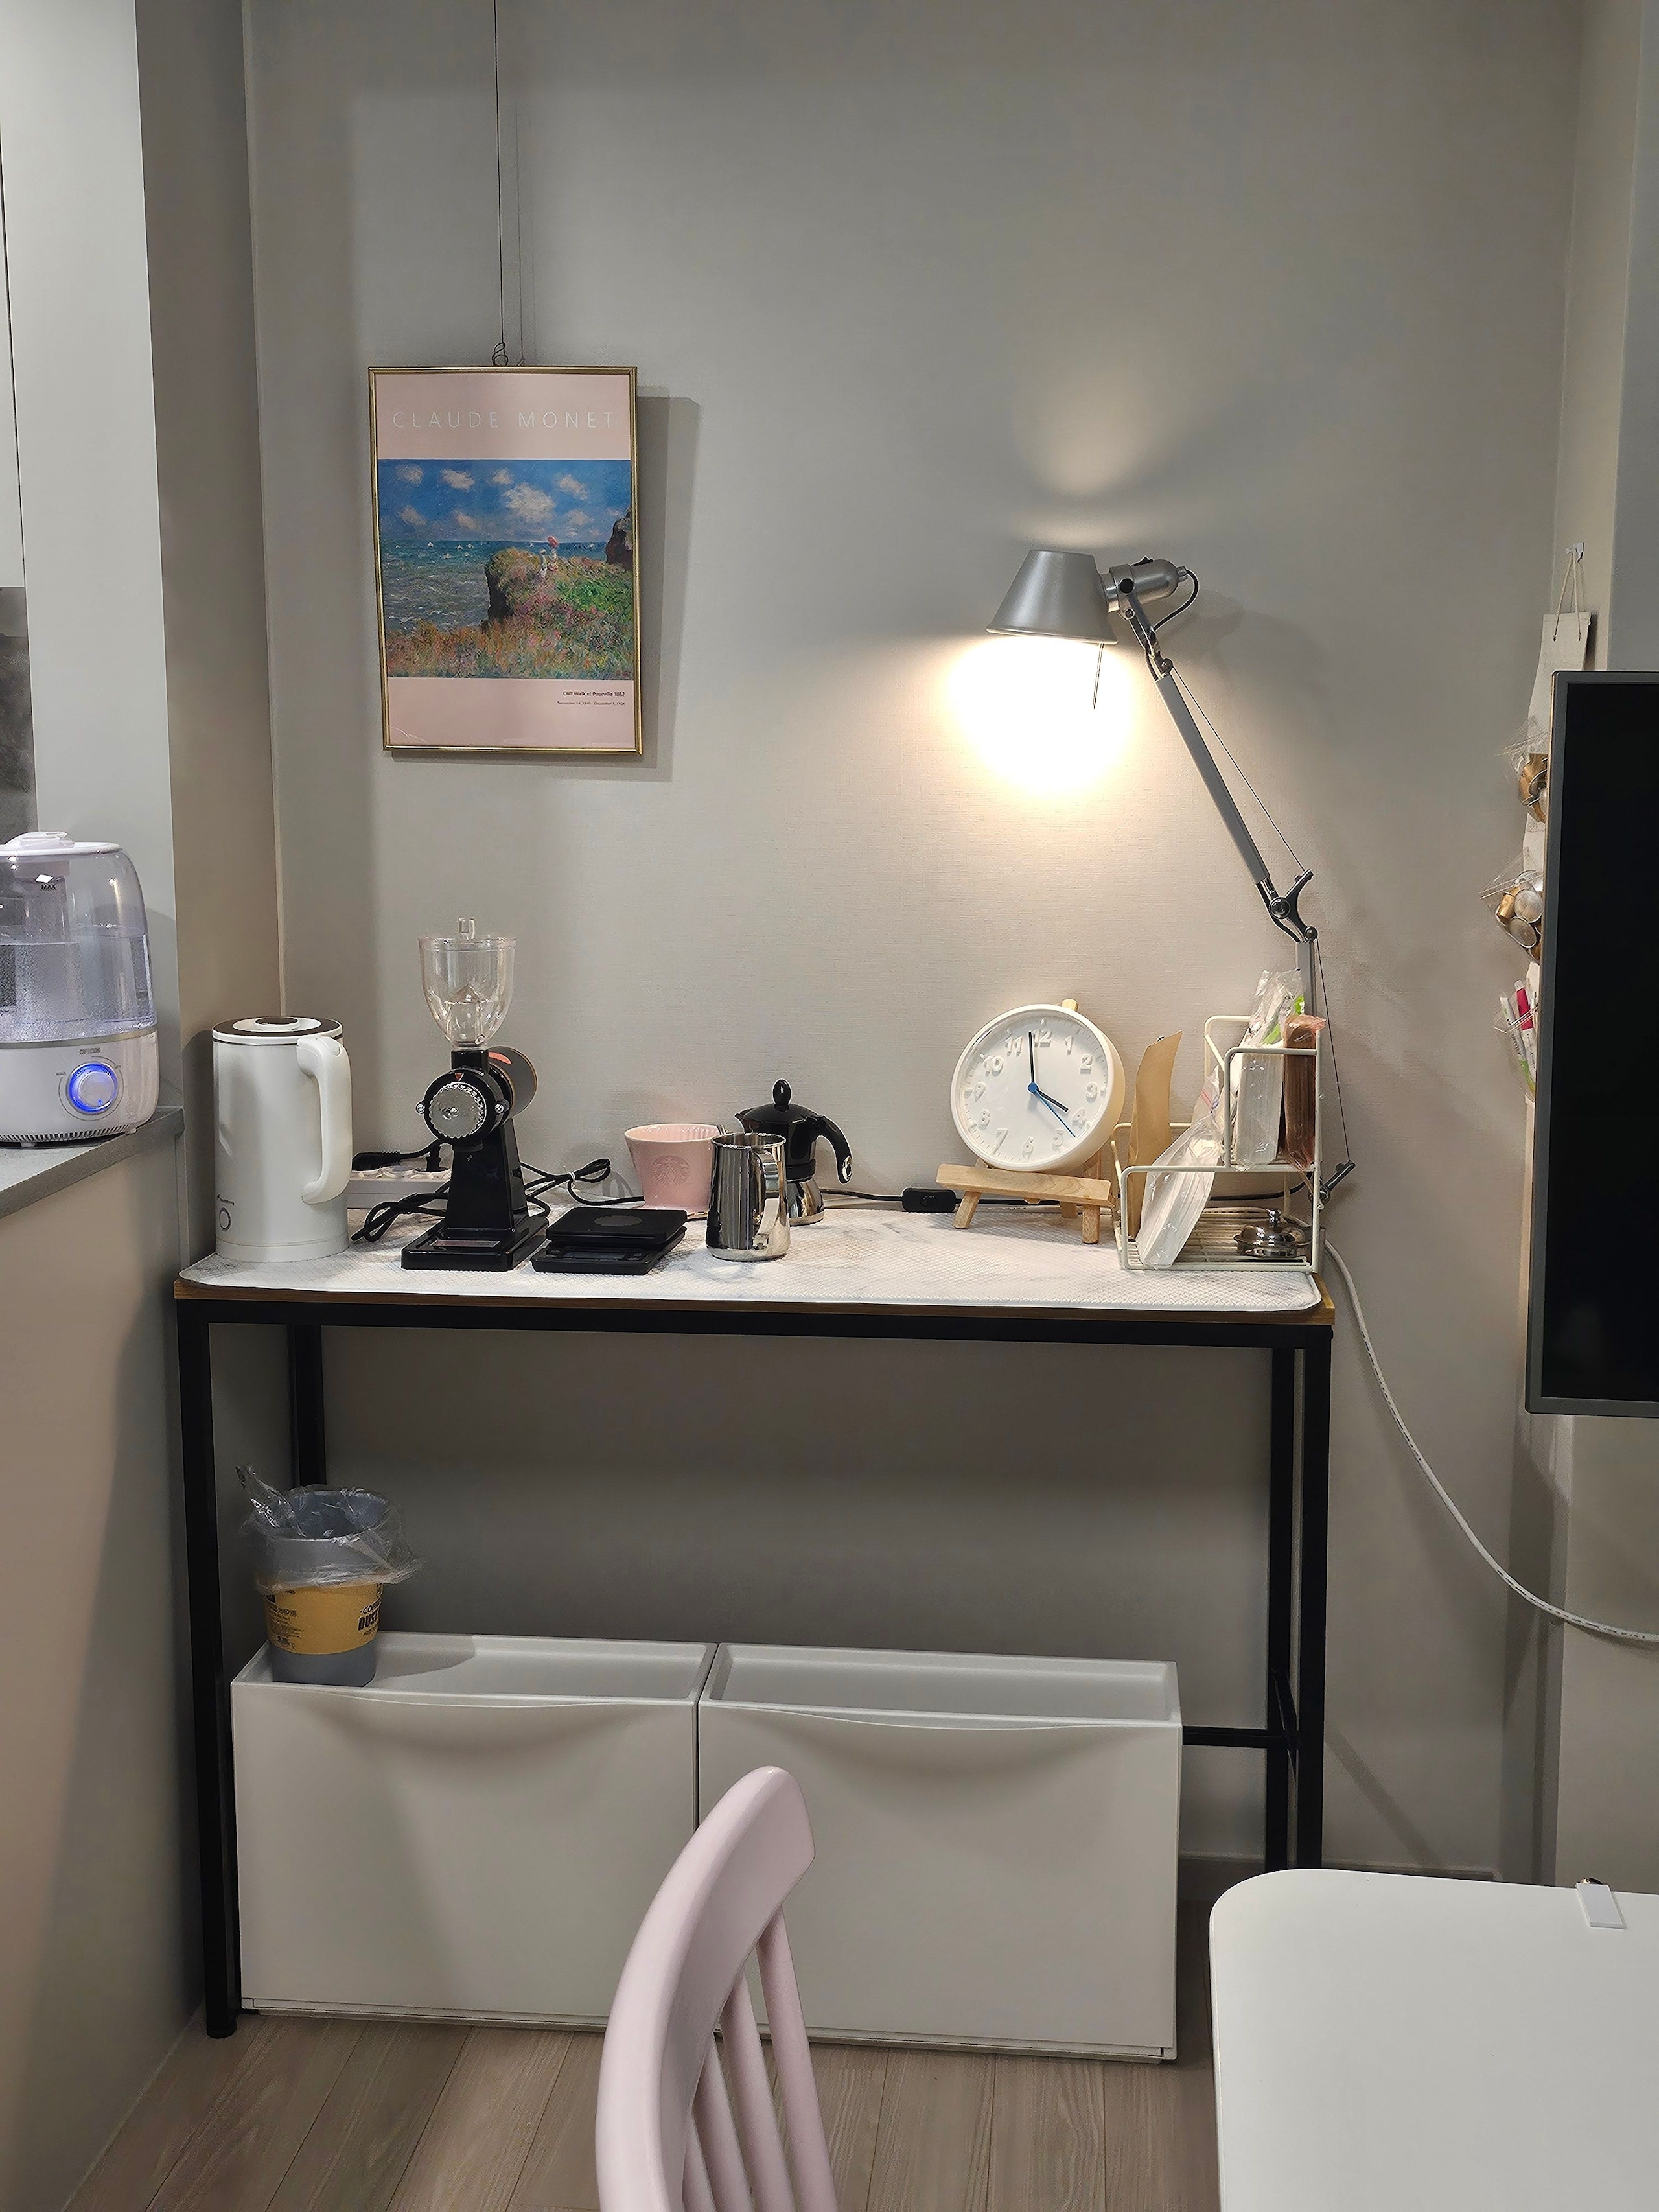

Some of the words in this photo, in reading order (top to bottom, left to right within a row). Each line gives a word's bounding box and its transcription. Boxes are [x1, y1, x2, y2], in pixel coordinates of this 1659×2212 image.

[393, 411, 498, 428] CLAUDE
[518, 411, 614, 428] MONET
[1005, 1036, 1023, 1054] 11
[1032, 1028, 1052, 1045] 12
[1065, 1035, 1074, 1053] 1
[1080, 1053, 1093, 1071] 2
